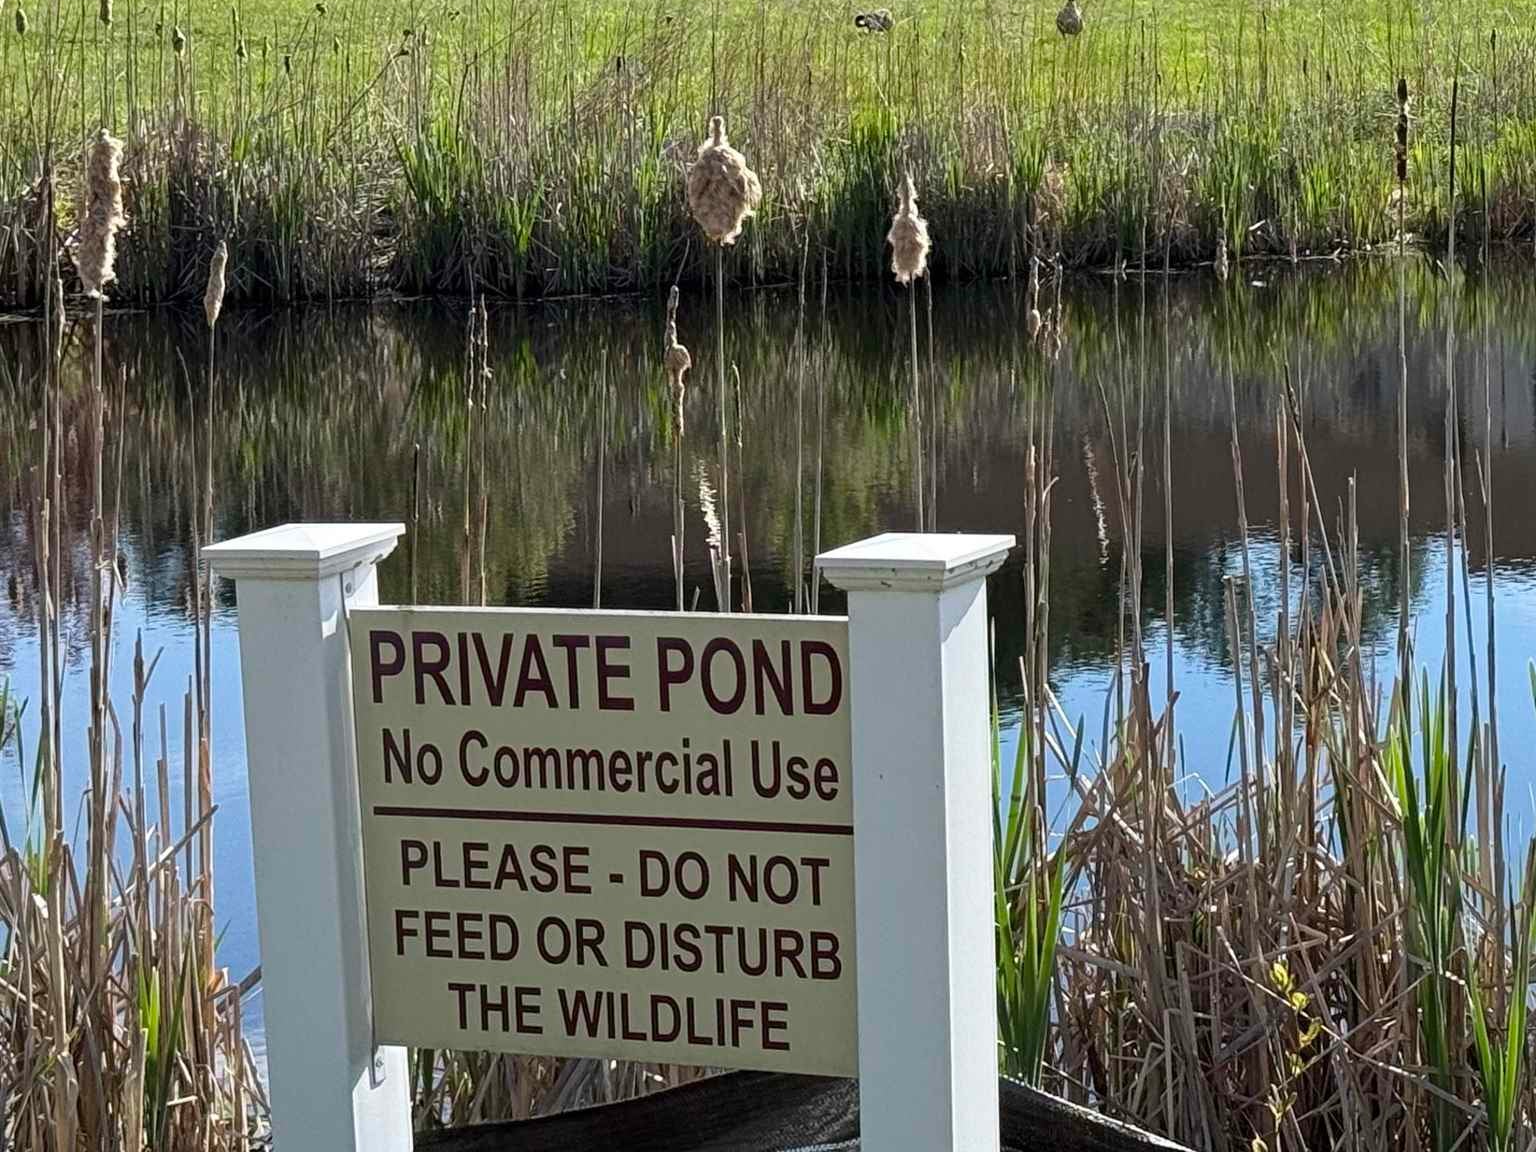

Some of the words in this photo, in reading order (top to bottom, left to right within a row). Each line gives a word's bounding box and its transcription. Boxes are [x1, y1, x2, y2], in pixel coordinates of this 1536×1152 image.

[370, 630, 634, 711] PRIVATE
[657, 637, 842, 716] POND
[382, 728, 442, 785] No
[459, 730, 733, 797] Commercial
[751, 740, 839, 801] Use
[401, 840, 592, 894] PLEASE
[639, 850, 709, 900] DO
[728, 854, 830, 906] NOT
[395, 909, 519, 961] FEED
[537, 916, 608, 967] OR
[624, 921, 841, 980] DISTURB
[448, 983, 543, 1034] THE
[557, 989, 790, 1051] WILDLIFE
